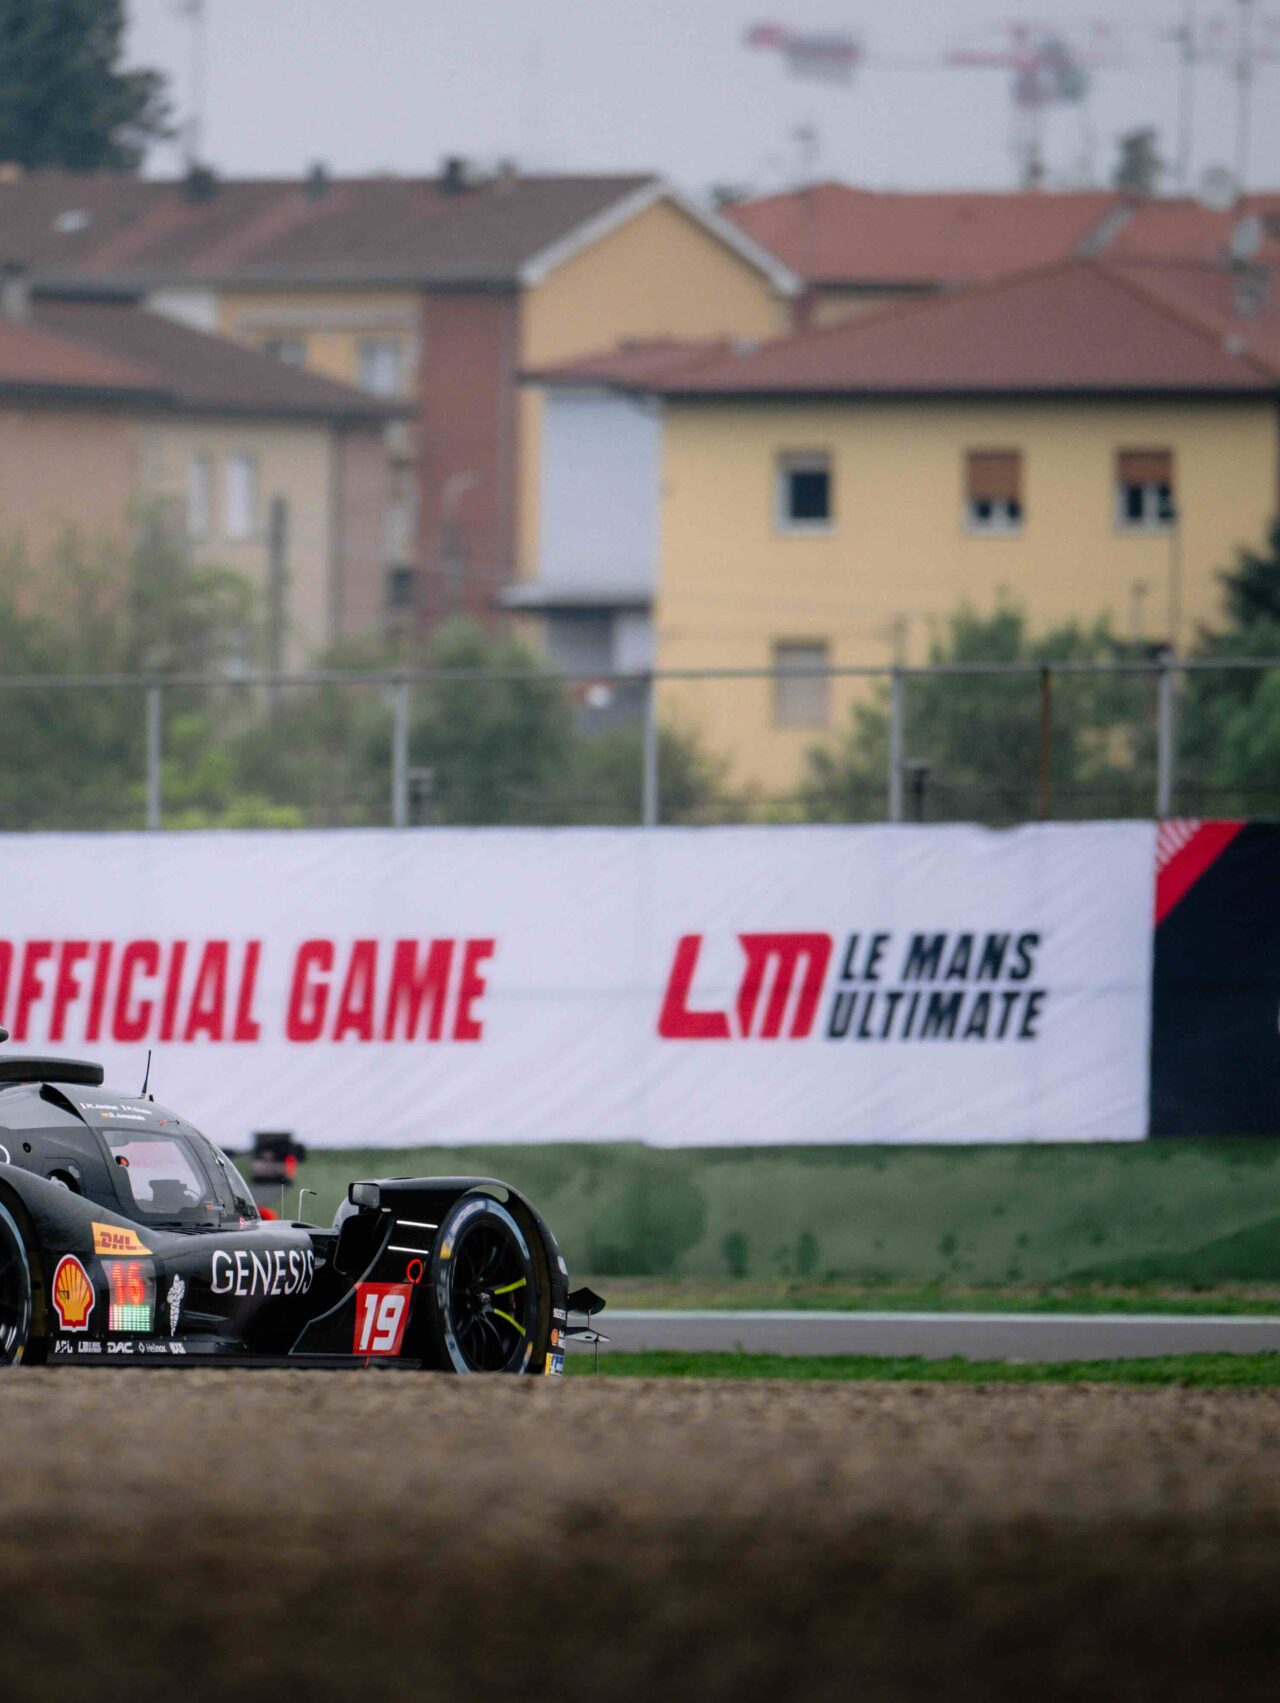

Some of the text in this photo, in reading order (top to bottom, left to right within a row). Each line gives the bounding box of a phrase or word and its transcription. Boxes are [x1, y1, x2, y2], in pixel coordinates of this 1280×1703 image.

[838, 932, 1042, 983] LE MANS
[284, 937, 497, 1043] GAME
[825, 990, 1047, 1042] ULTIMATE
[99, 1231, 138, 1250] DHL
[211, 1249, 314, 1296] GENESIS
[359, 1294, 406, 1351] 19
